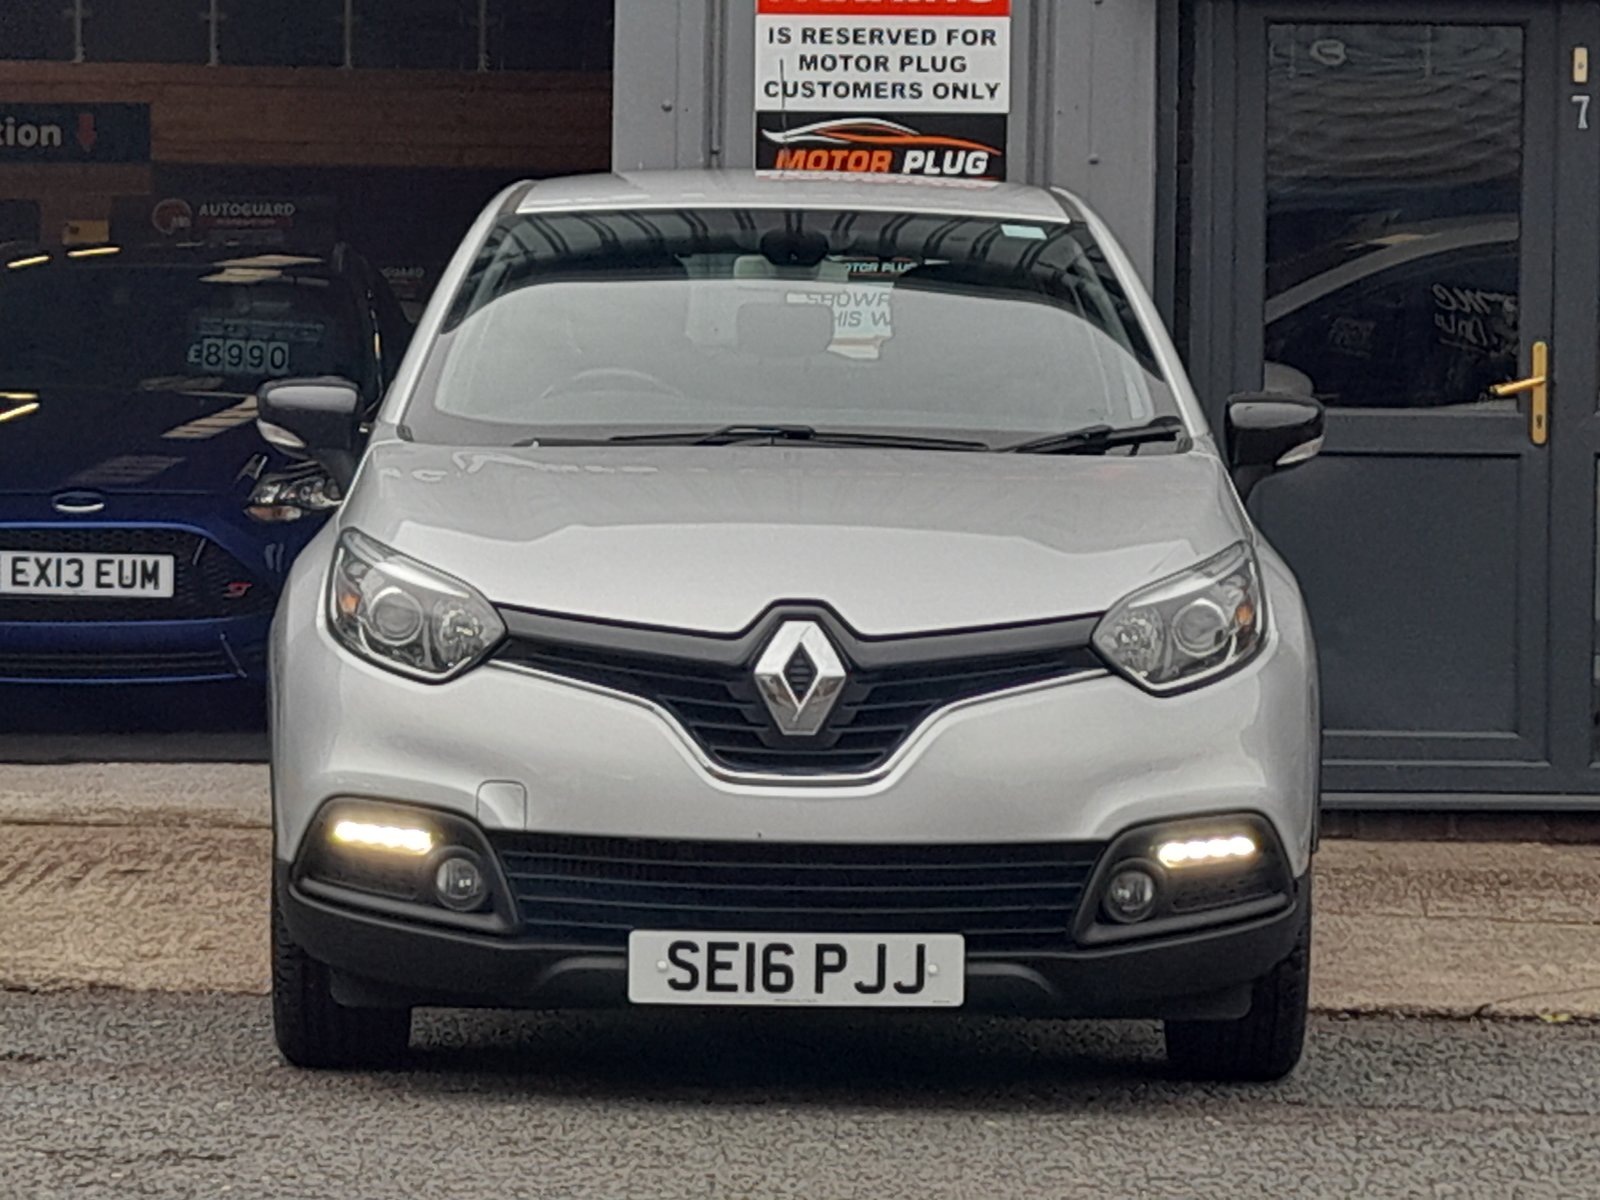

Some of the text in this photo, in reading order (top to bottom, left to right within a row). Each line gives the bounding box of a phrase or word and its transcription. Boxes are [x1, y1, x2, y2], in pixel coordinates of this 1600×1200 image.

[768, 27, 997, 46] IS RESERVED FOR
[798, 54, 967, 73] MOTOR PLUG
[763, 80, 1000, 100] CUSTOMERS ONLY
[1571, 95, 1590, 129] 7
[774, 149, 989, 175] MOTOR PLUG
[198, 203, 296, 217] AUTOGUARD
[11, 556, 160, 590] EX13 EUM
[667, 940, 926, 995] SE16 PJJ
